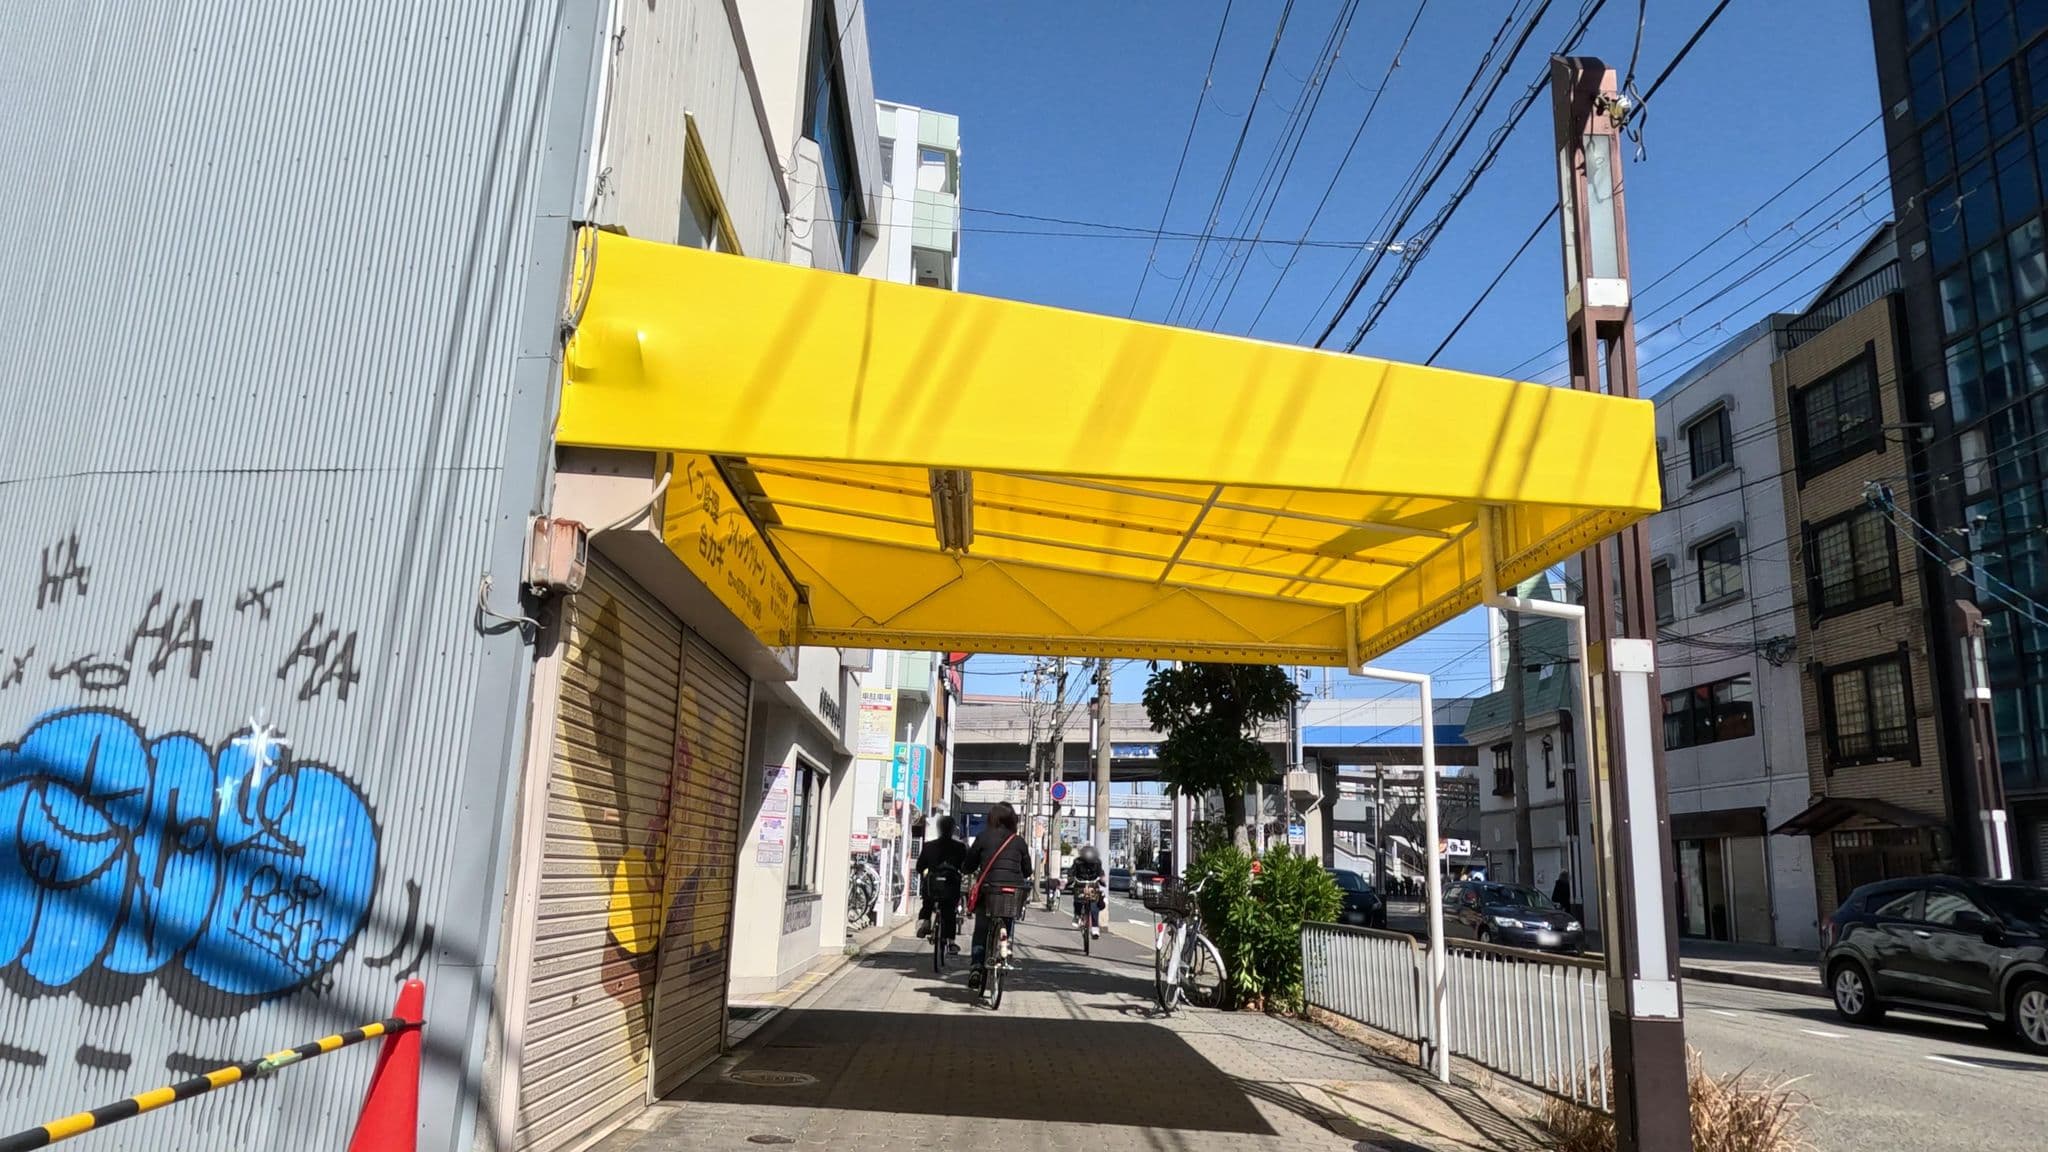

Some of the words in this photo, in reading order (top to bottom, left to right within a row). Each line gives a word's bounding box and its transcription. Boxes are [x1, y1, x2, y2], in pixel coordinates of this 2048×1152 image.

[36, 528, 91, 611] HA
[698, 524, 726, 576] 合カギ
[123, 587, 214, 681] HA
[276, 611, 361, 702] HA
